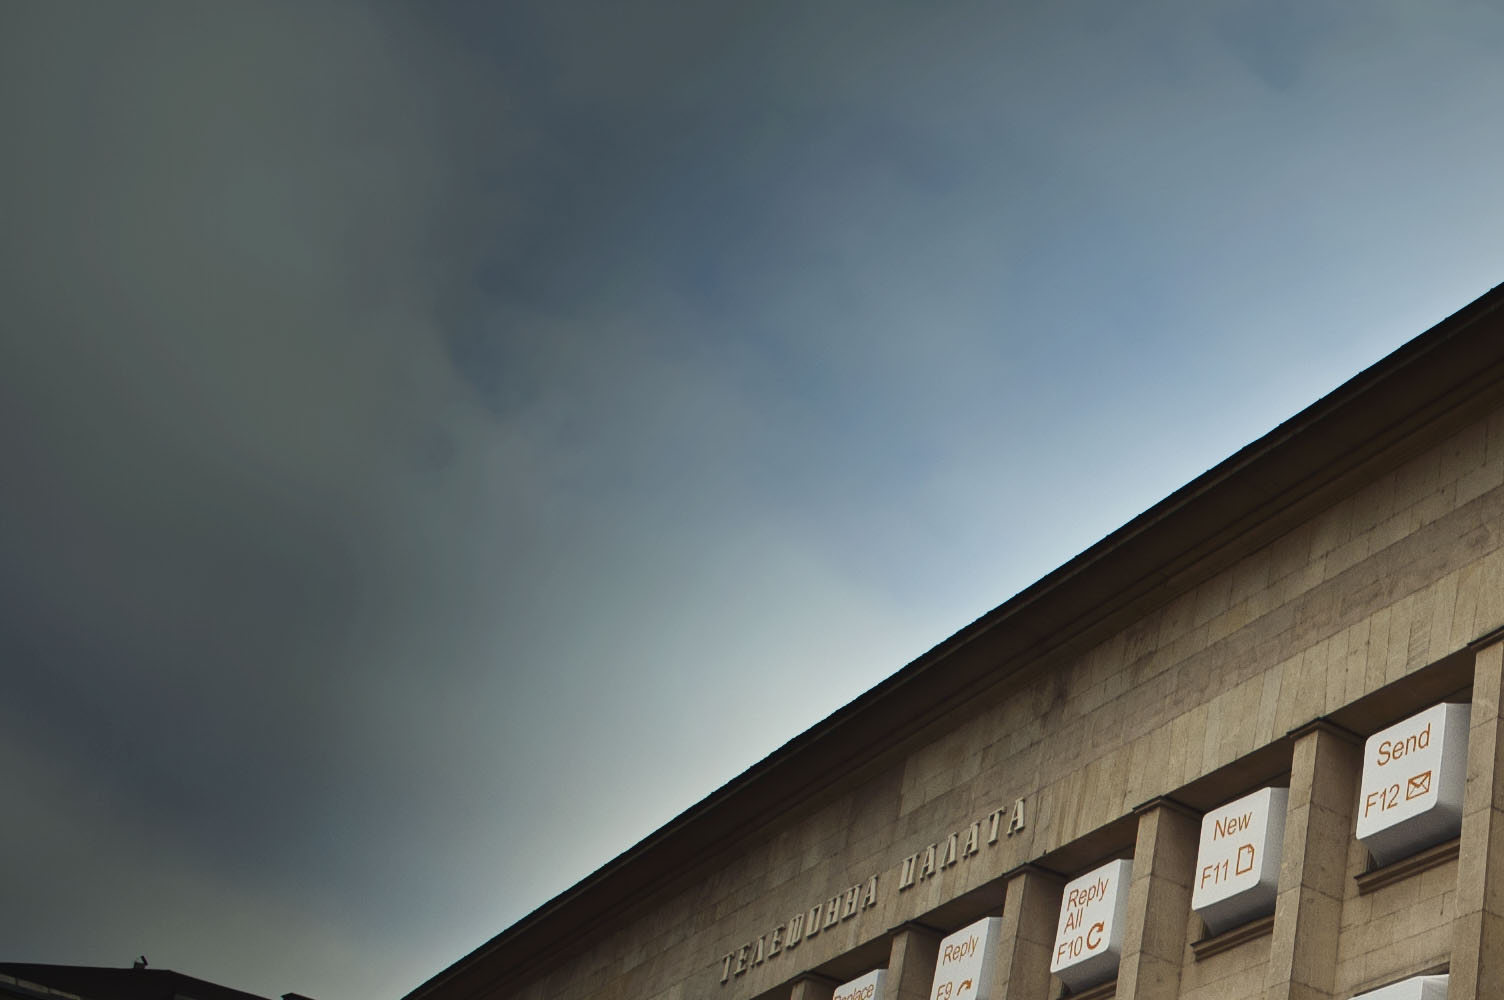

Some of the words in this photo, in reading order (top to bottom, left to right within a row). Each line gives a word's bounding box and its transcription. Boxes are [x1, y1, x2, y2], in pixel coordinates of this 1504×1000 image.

[1376, 722, 1432, 767] Send
[1364, 783, 1401, 819] F12
[1212, 811, 1253, 841] New
[899, 797, 1026, 891] ПАЛАТА
[1200, 858, 1230, 890] F11
[1066, 876, 1110, 912] Reply
[1063, 908, 1084, 935] All
[942, 934, 980, 967] Reply
[1056, 935, 1084, 965] F10
